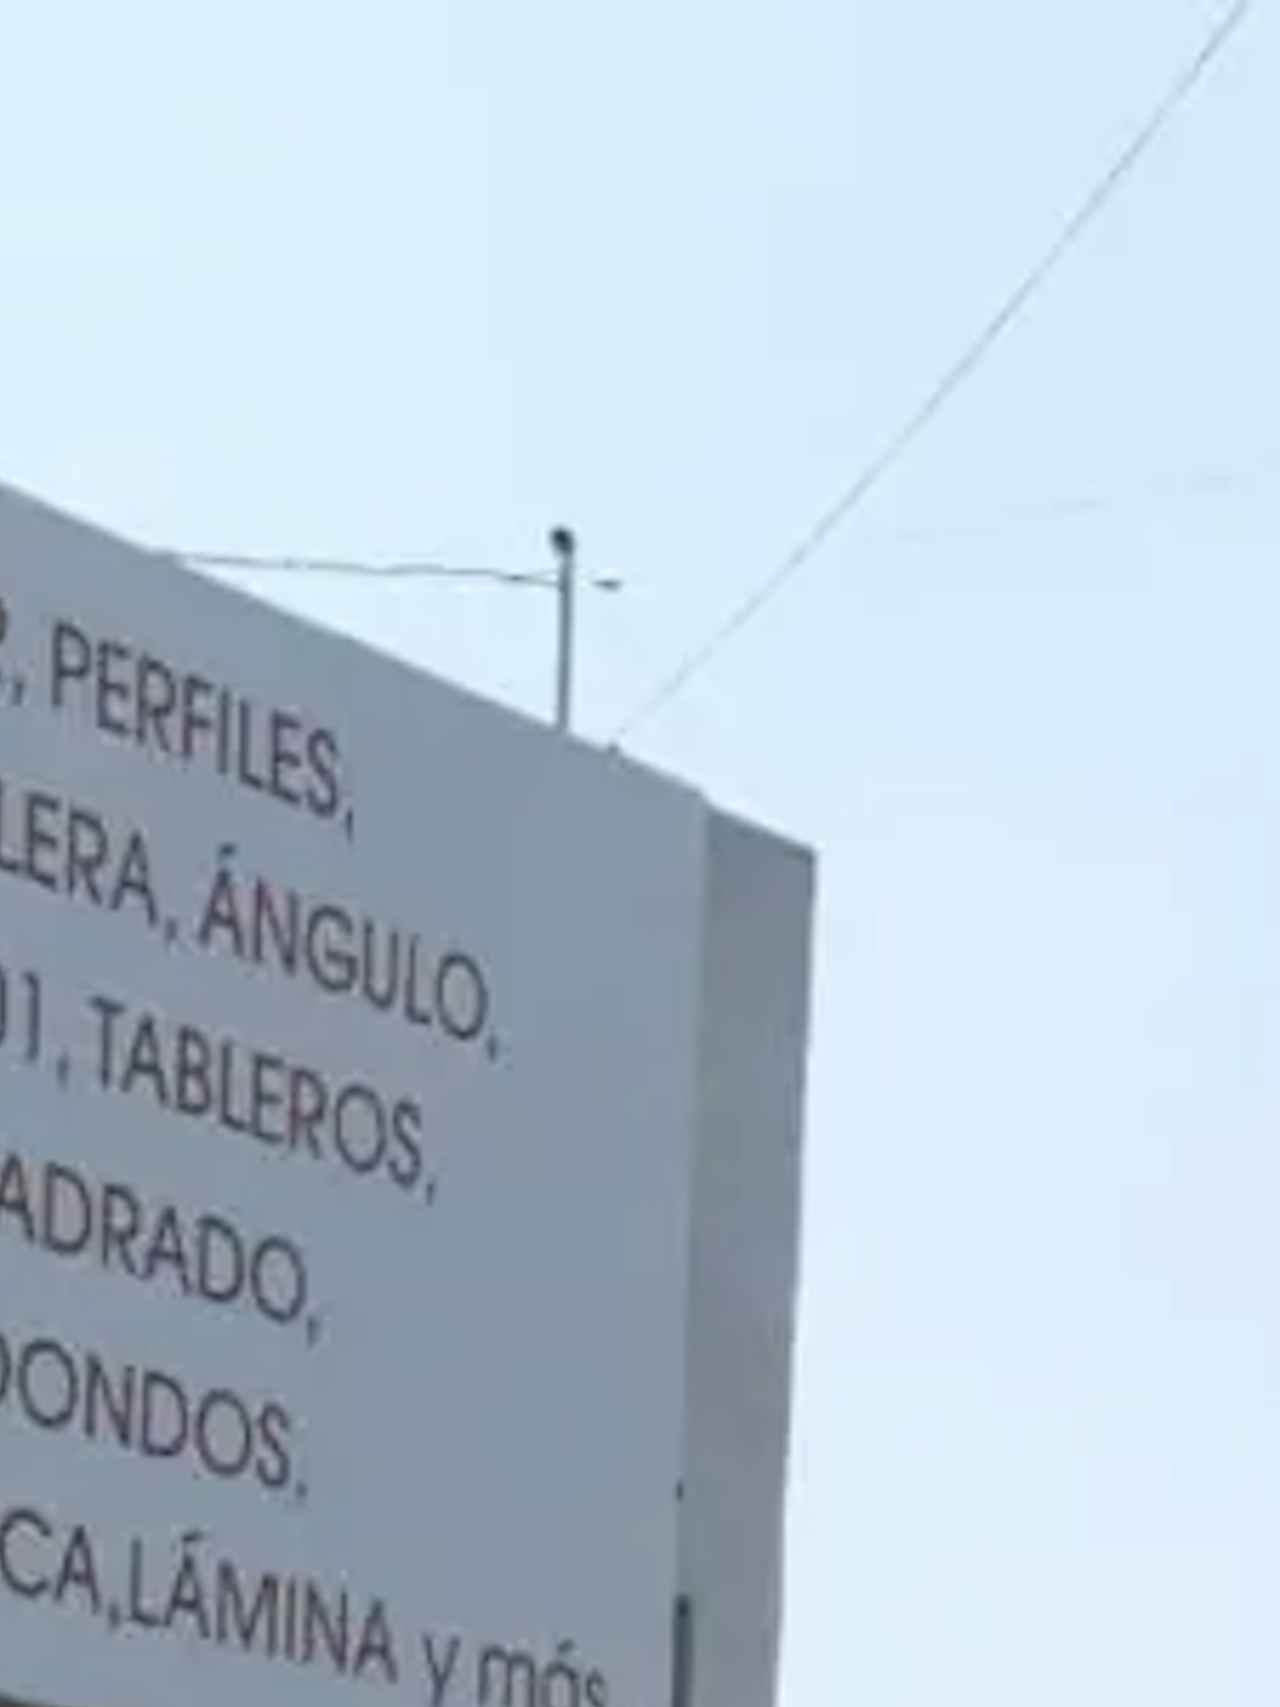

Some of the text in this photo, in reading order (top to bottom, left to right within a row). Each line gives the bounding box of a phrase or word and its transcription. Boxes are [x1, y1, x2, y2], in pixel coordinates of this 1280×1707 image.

[50, 618, 357, 842] PERFILES,
[196, 844, 505, 1064] ÁNGULO,
[90, 995, 438, 1206] TABLEROS,
